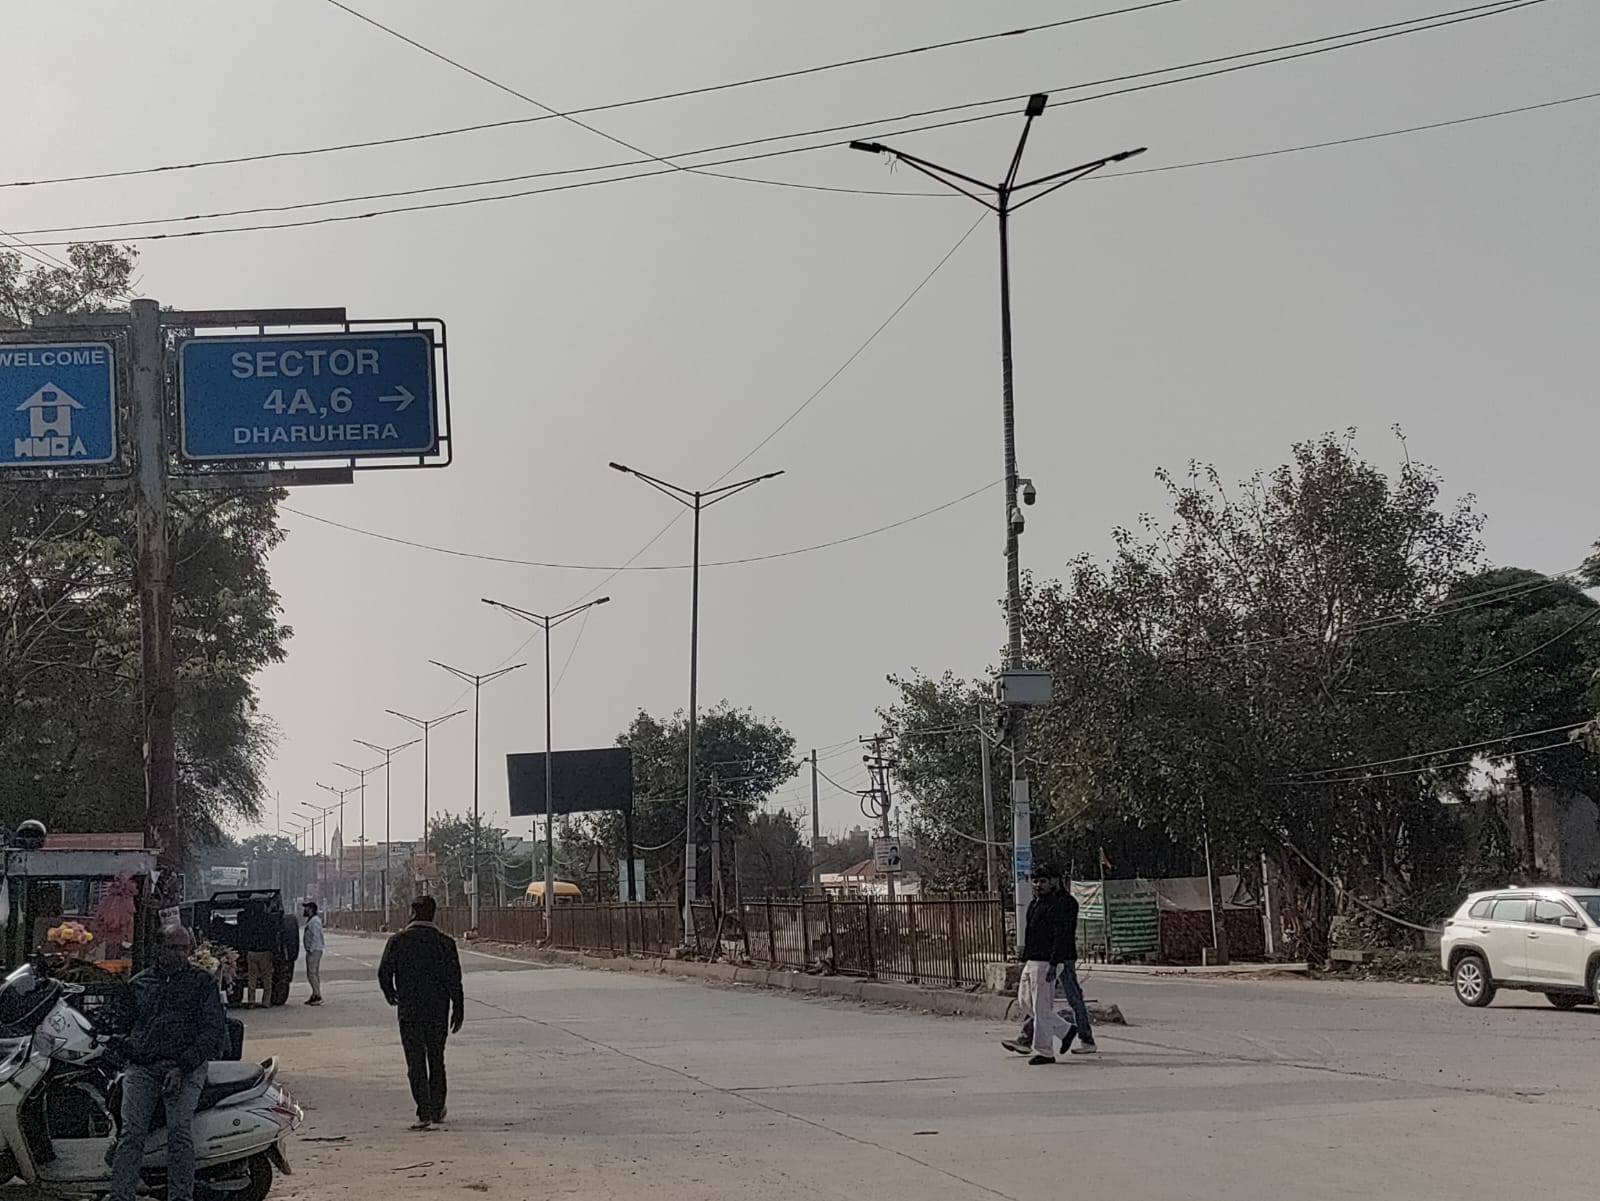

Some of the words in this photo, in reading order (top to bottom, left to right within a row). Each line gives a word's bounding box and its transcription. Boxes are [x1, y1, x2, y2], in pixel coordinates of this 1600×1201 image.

[231, 349, 380, 379] SECTOR
[262, 387, 353, 419] 4A,6
[233, 423, 399, 444] DHARUHERA
